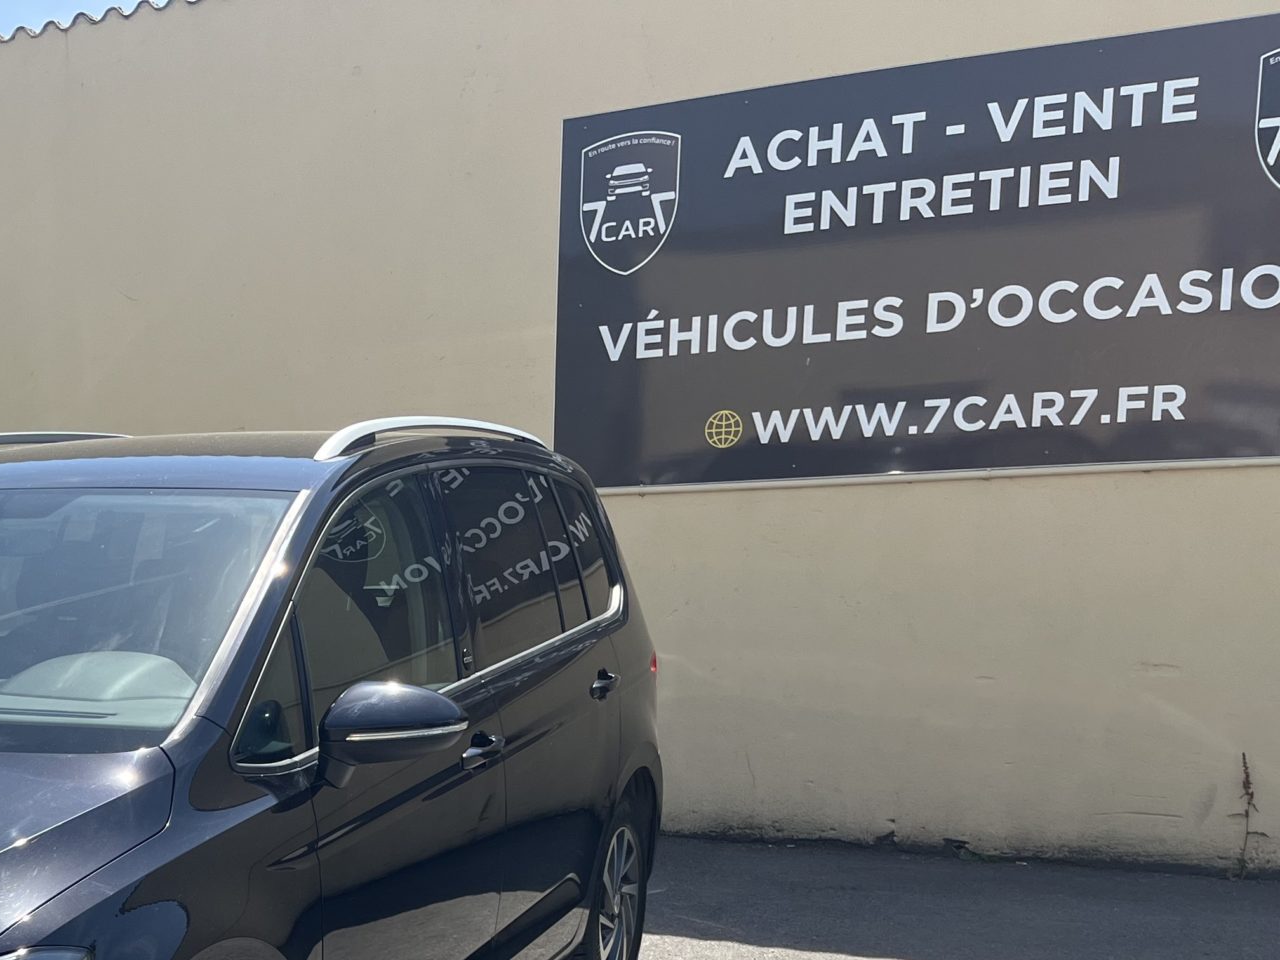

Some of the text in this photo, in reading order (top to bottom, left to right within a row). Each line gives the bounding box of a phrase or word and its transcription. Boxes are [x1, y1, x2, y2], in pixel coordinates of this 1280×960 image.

[587, 150, 598, 158] En
[598, 143, 616, 154] route
[617, 140, 631, 148] vers
[639, 136, 671, 146] confiance
[723, 111, 927, 179] ACHAT
[987, 76, 1200, 143] VENTE
[783, 156, 1120, 235] ENTRETIEN
[599, 296, 904, 362] VÉHICULES
[752, 384, 1186, 444] WWW.7CAR7.FR
